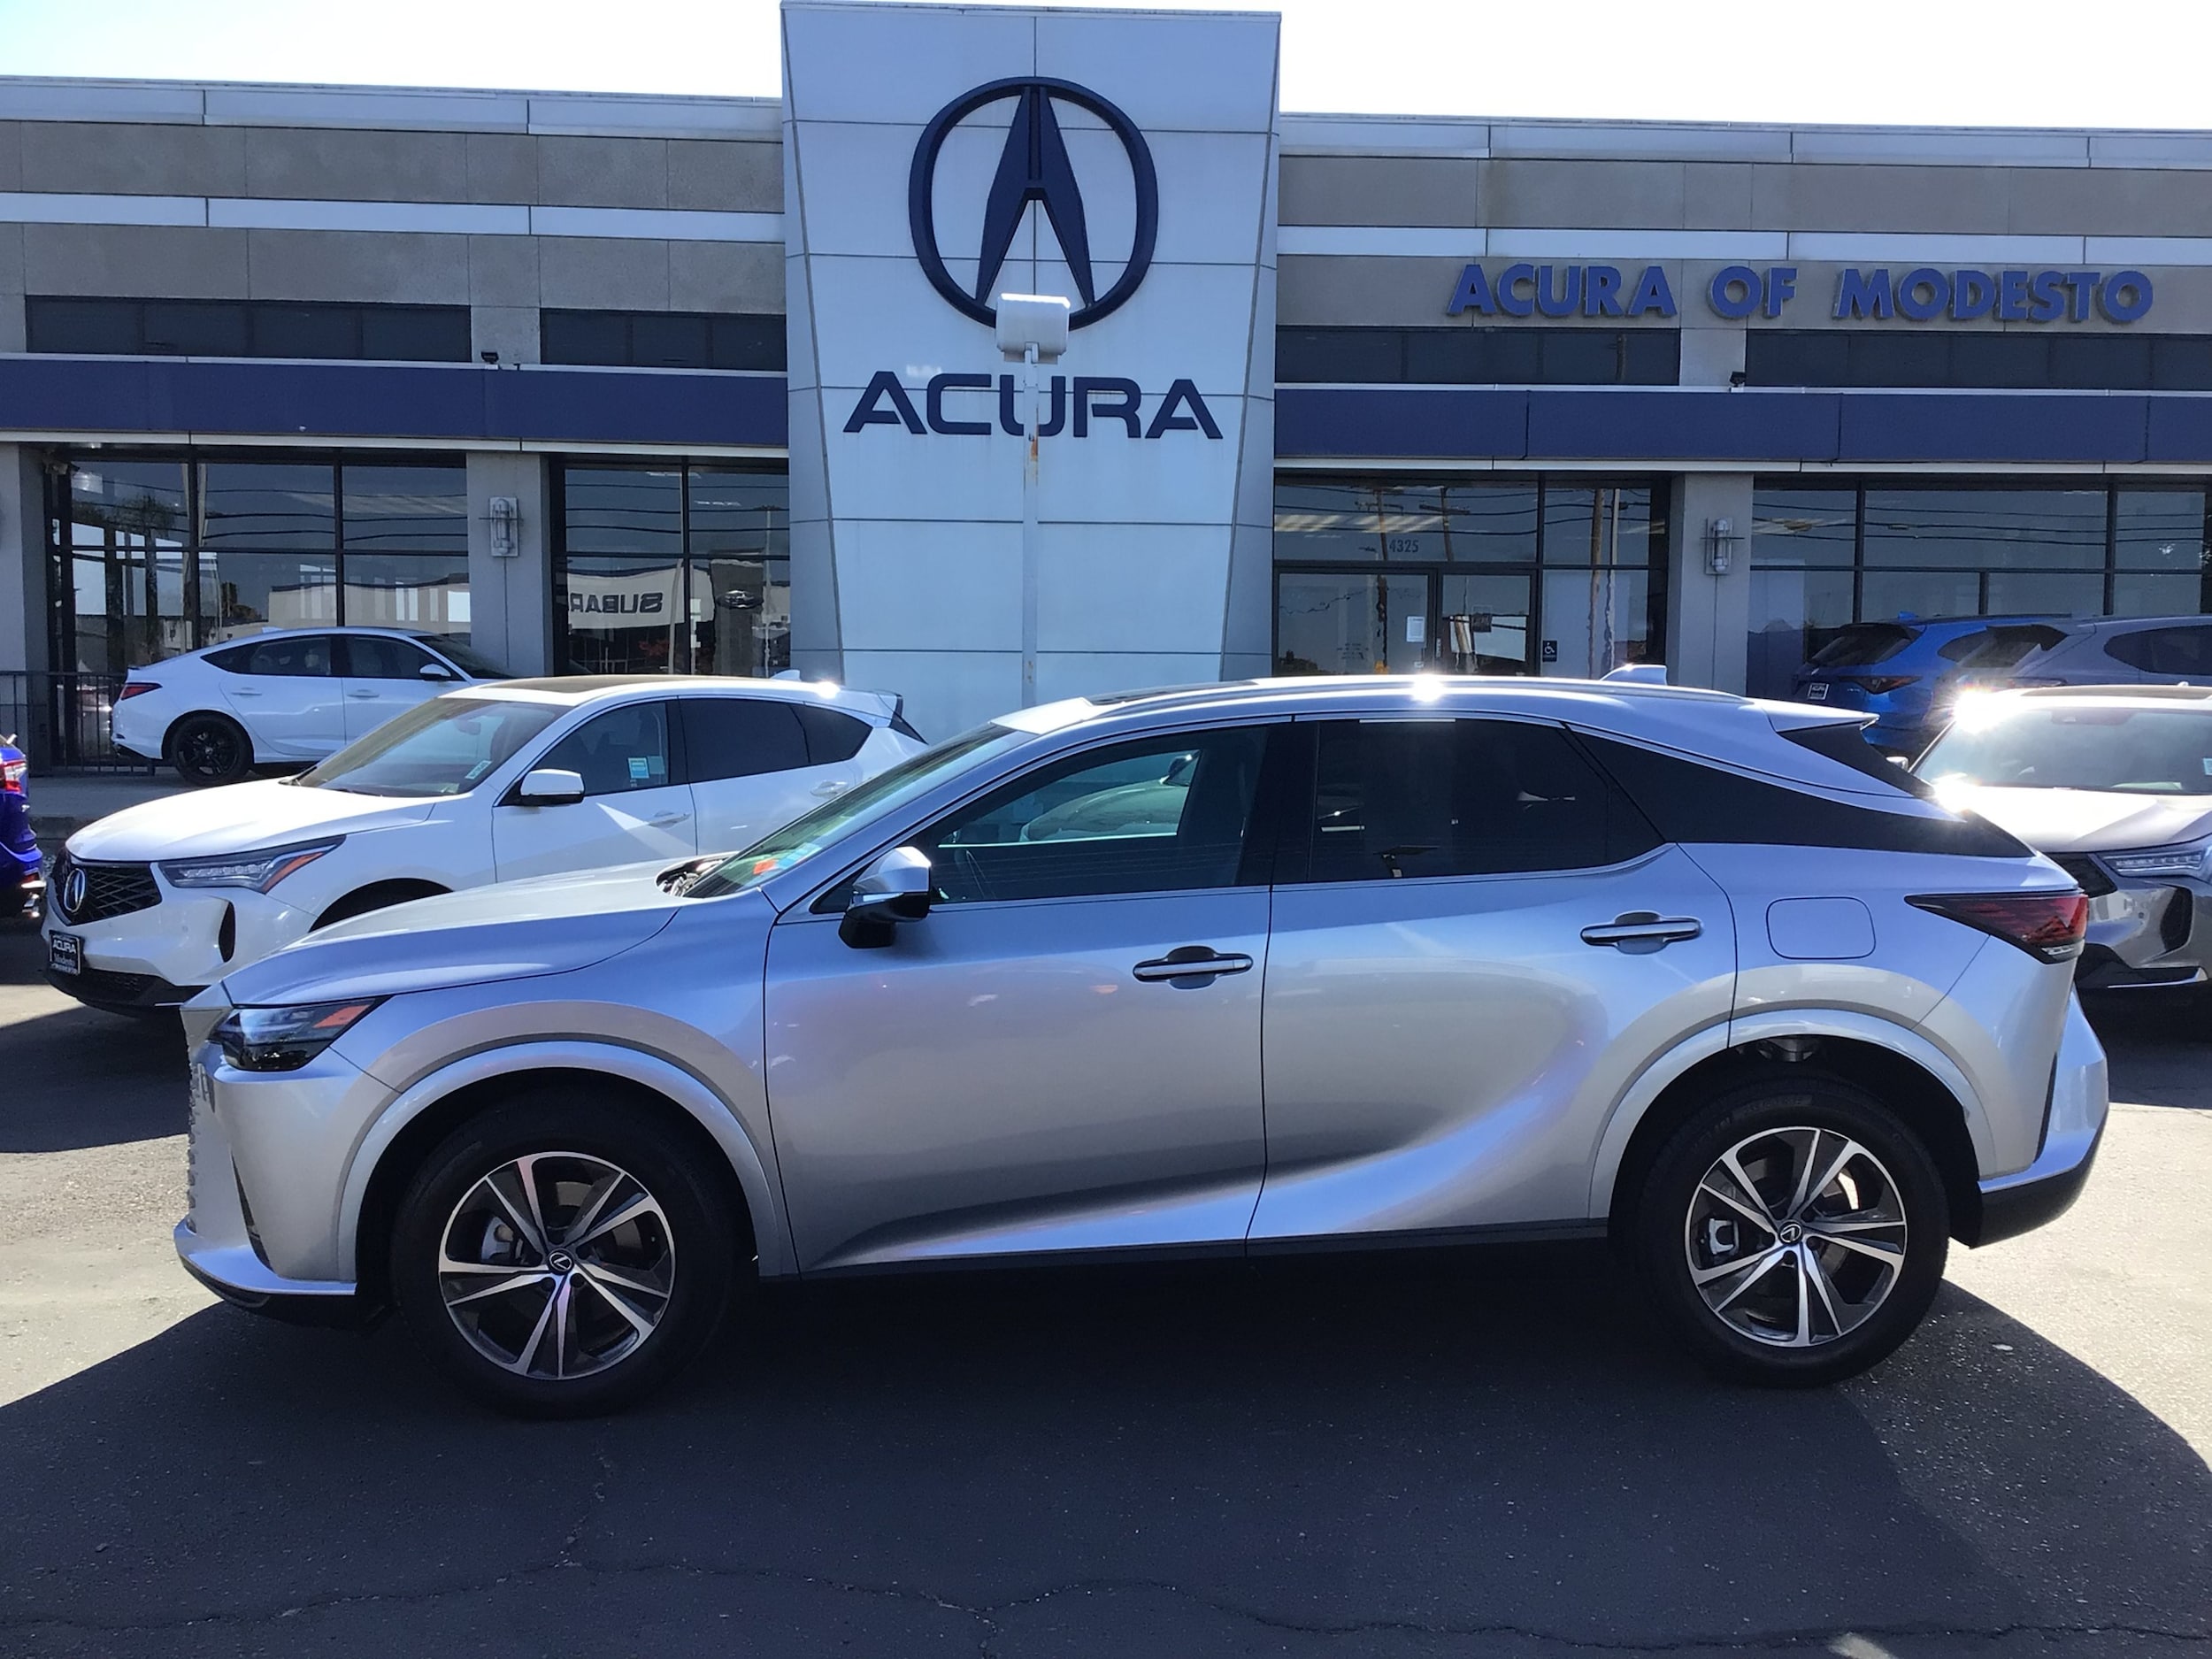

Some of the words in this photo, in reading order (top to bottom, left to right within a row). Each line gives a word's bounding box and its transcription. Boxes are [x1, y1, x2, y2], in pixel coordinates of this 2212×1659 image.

[1446, 263, 1678, 318] ACURA
[1708, 265, 1798, 319] OF
[1832, 267, 2154, 324] MODESTO
[842, 370, 1224, 440] ACURA
[1389, 539, 1419, 553] 4325
